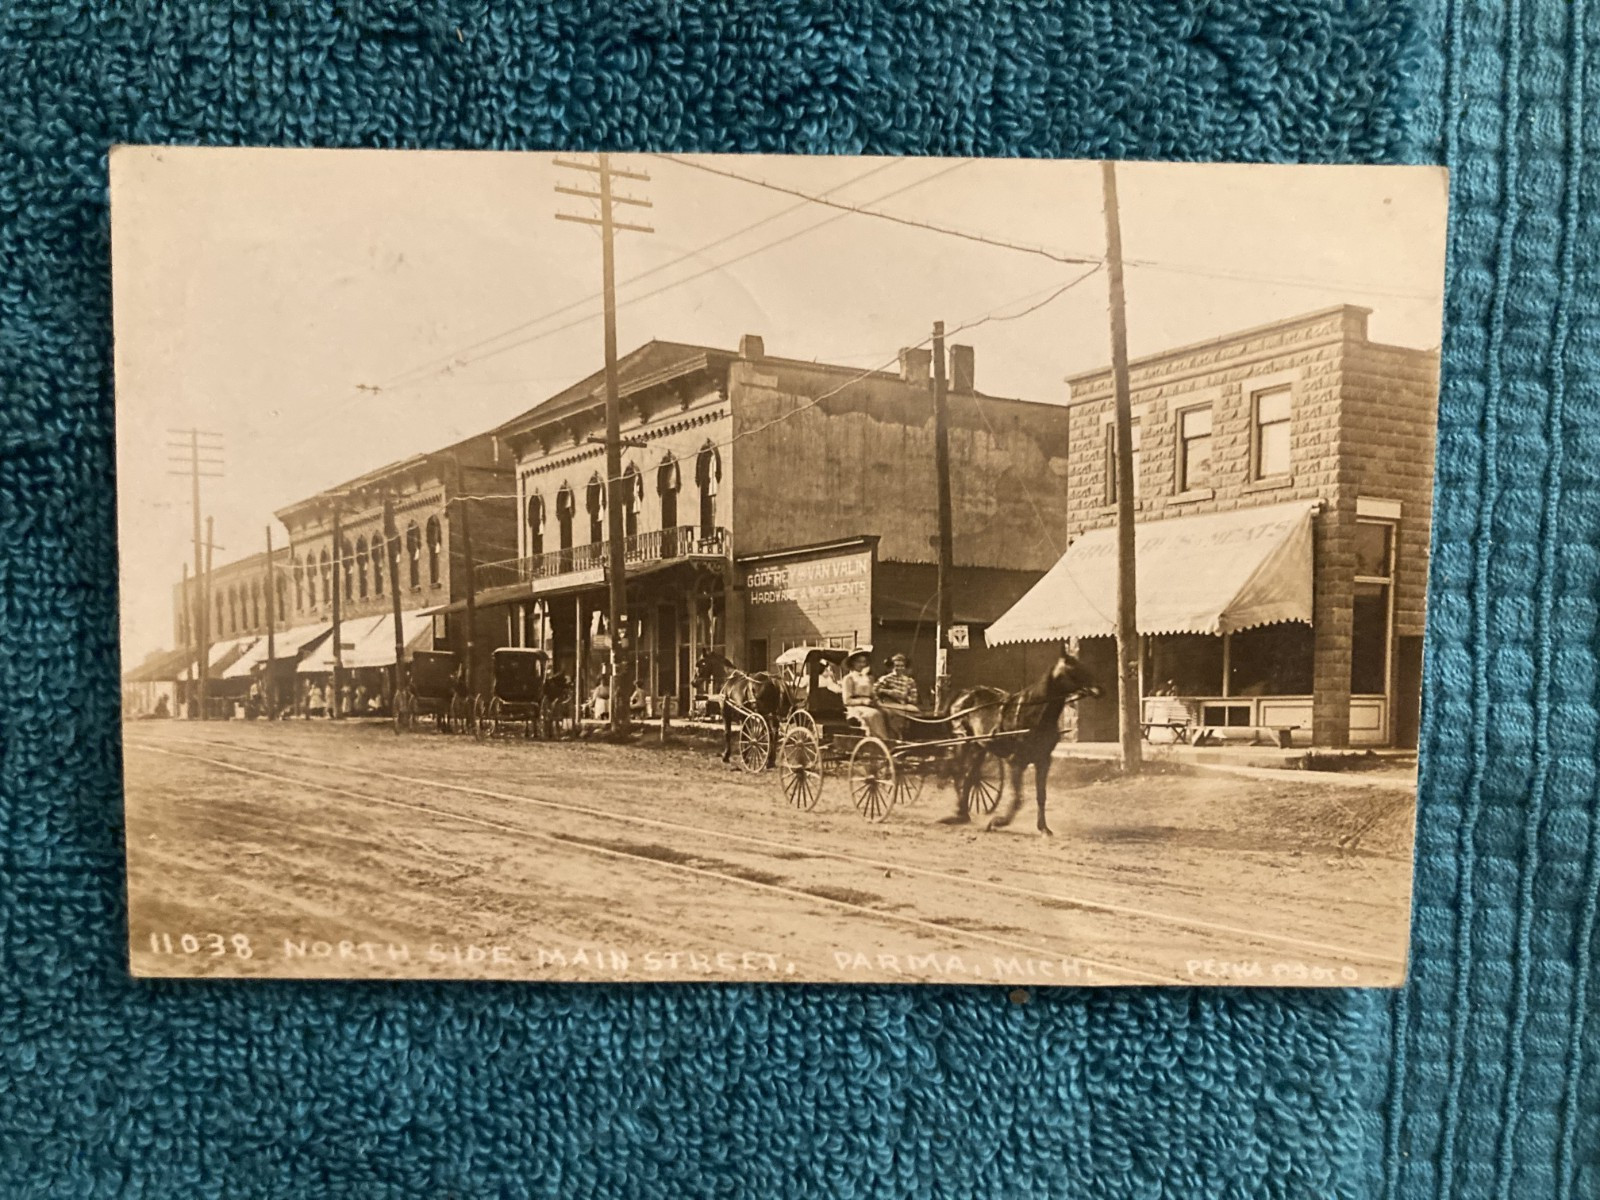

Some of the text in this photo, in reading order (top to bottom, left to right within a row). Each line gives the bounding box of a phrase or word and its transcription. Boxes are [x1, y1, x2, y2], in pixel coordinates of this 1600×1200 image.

[747, 567, 797, 588] GODFREY
[808, 563, 831, 581] VAN
[751, 588, 798, 605] HARDWARE
[150, 932, 253, 960] 11038
[284, 937, 409, 961] NORTH
[428, 942, 512, 966] SIDE
[537, 947, 630, 971] MAIN
